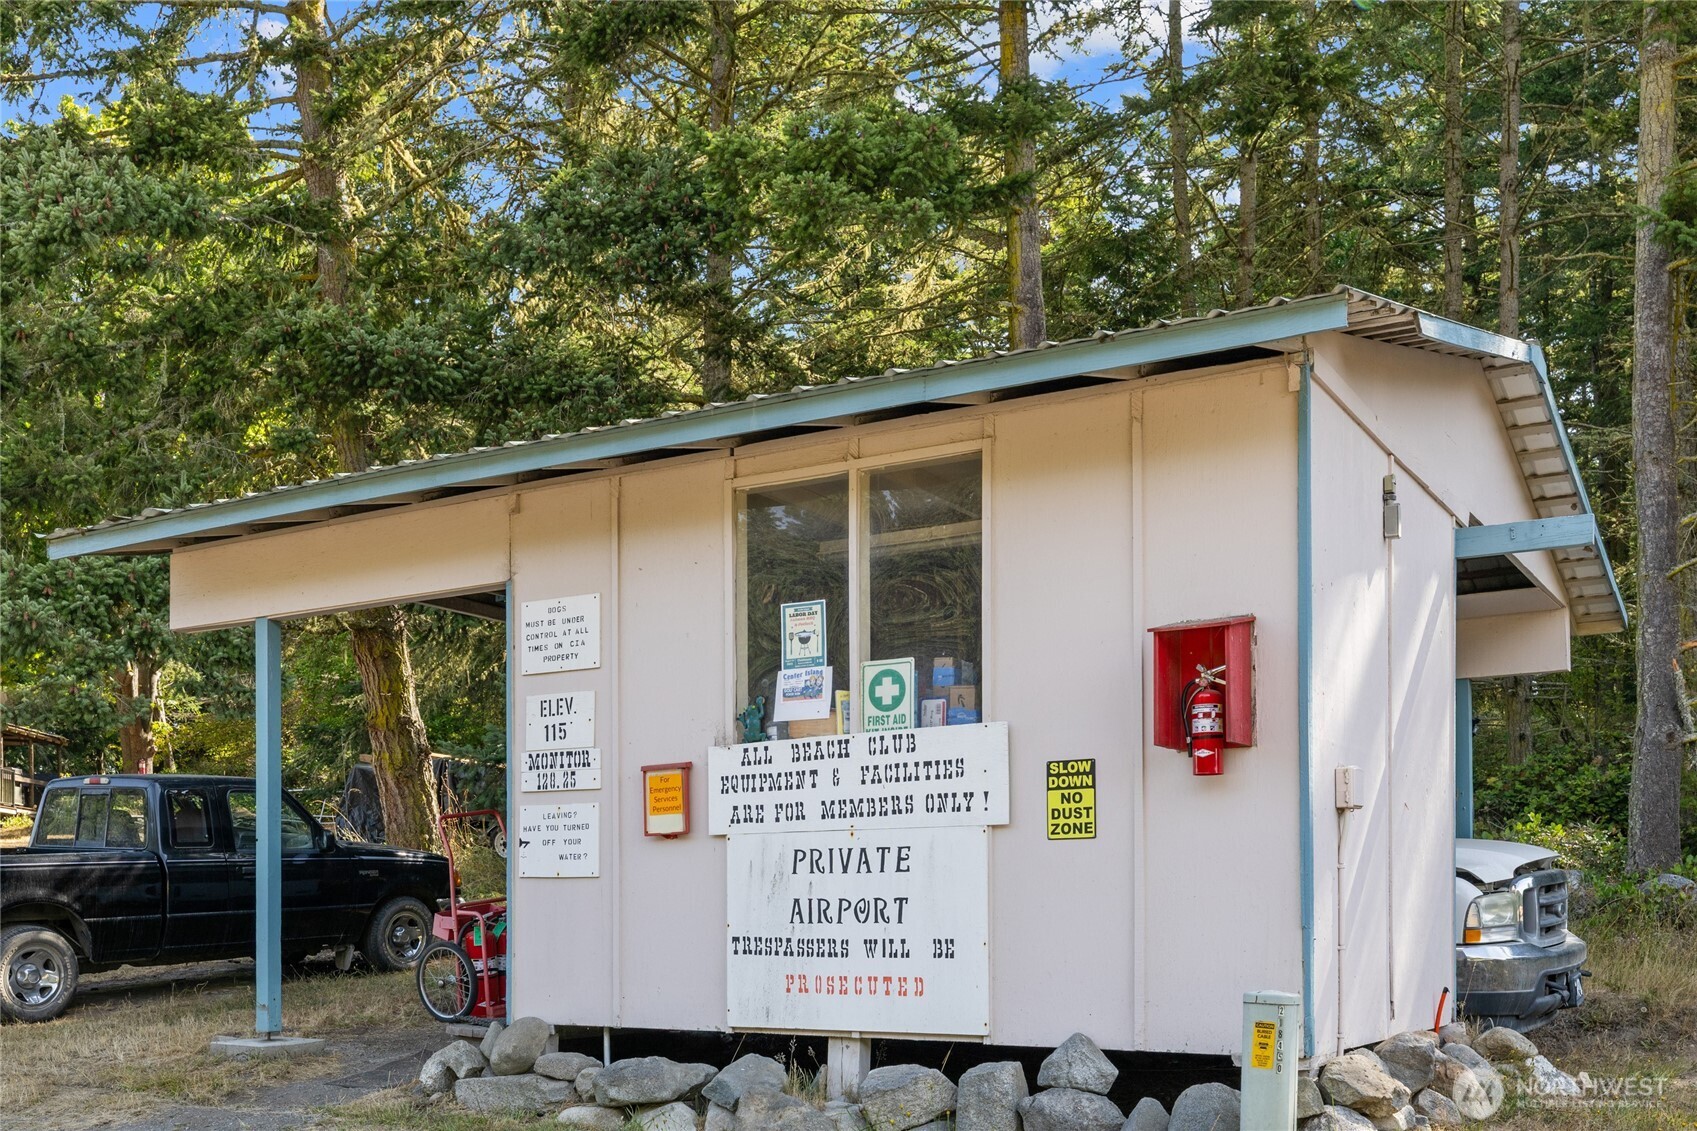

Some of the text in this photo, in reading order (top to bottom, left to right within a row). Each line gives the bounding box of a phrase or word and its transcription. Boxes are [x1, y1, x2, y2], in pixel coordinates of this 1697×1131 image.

[548, 605, 566, 614] DOGS
[526, 620, 544, 628] MUST
[562, 615, 584, 624] UNDER
[526, 632, 557, 641] CONTROL
[575, 627, 588, 635] ALL
[543, 653, 579, 662] PROPERTY
[783, 669, 823, 680] Center Island
[540, 697, 576, 717] ELEV.
[868, 713, 907, 726] FIRST AID
[741, 733, 916, 766] ALL BEACH CLUB
[528, 750, 591, 771] MONITOR
[1049, 760, 1091, 774] SLOW
[537, 771, 576, 790] 128.25
[720, 758, 964, 794] EQUIPMENT & FACILITIES
[1048, 774, 1093, 788] DOWN
[650, 786, 681, 794] Emergency
[1061, 792, 1083, 804] NO
[653, 804, 681, 812] Personnel
[730, 804, 764, 824] ARE
[774, 802, 806, 822] FOR
[821, 794, 913, 820] MEMBERS
[1051, 806, 1093, 820] DUST
[543, 811, 577, 820] LEAVING?
[563, 823, 590, 831] TURNED
[1050, 822, 1093, 835] ZONE
[791, 846, 911, 875] PRIVATE
[789, 897, 909, 924] AIRPORT
[732, 936, 955, 959] TRESPASSERS WILL BE
[785, 974, 924, 996] PROSECUTED
